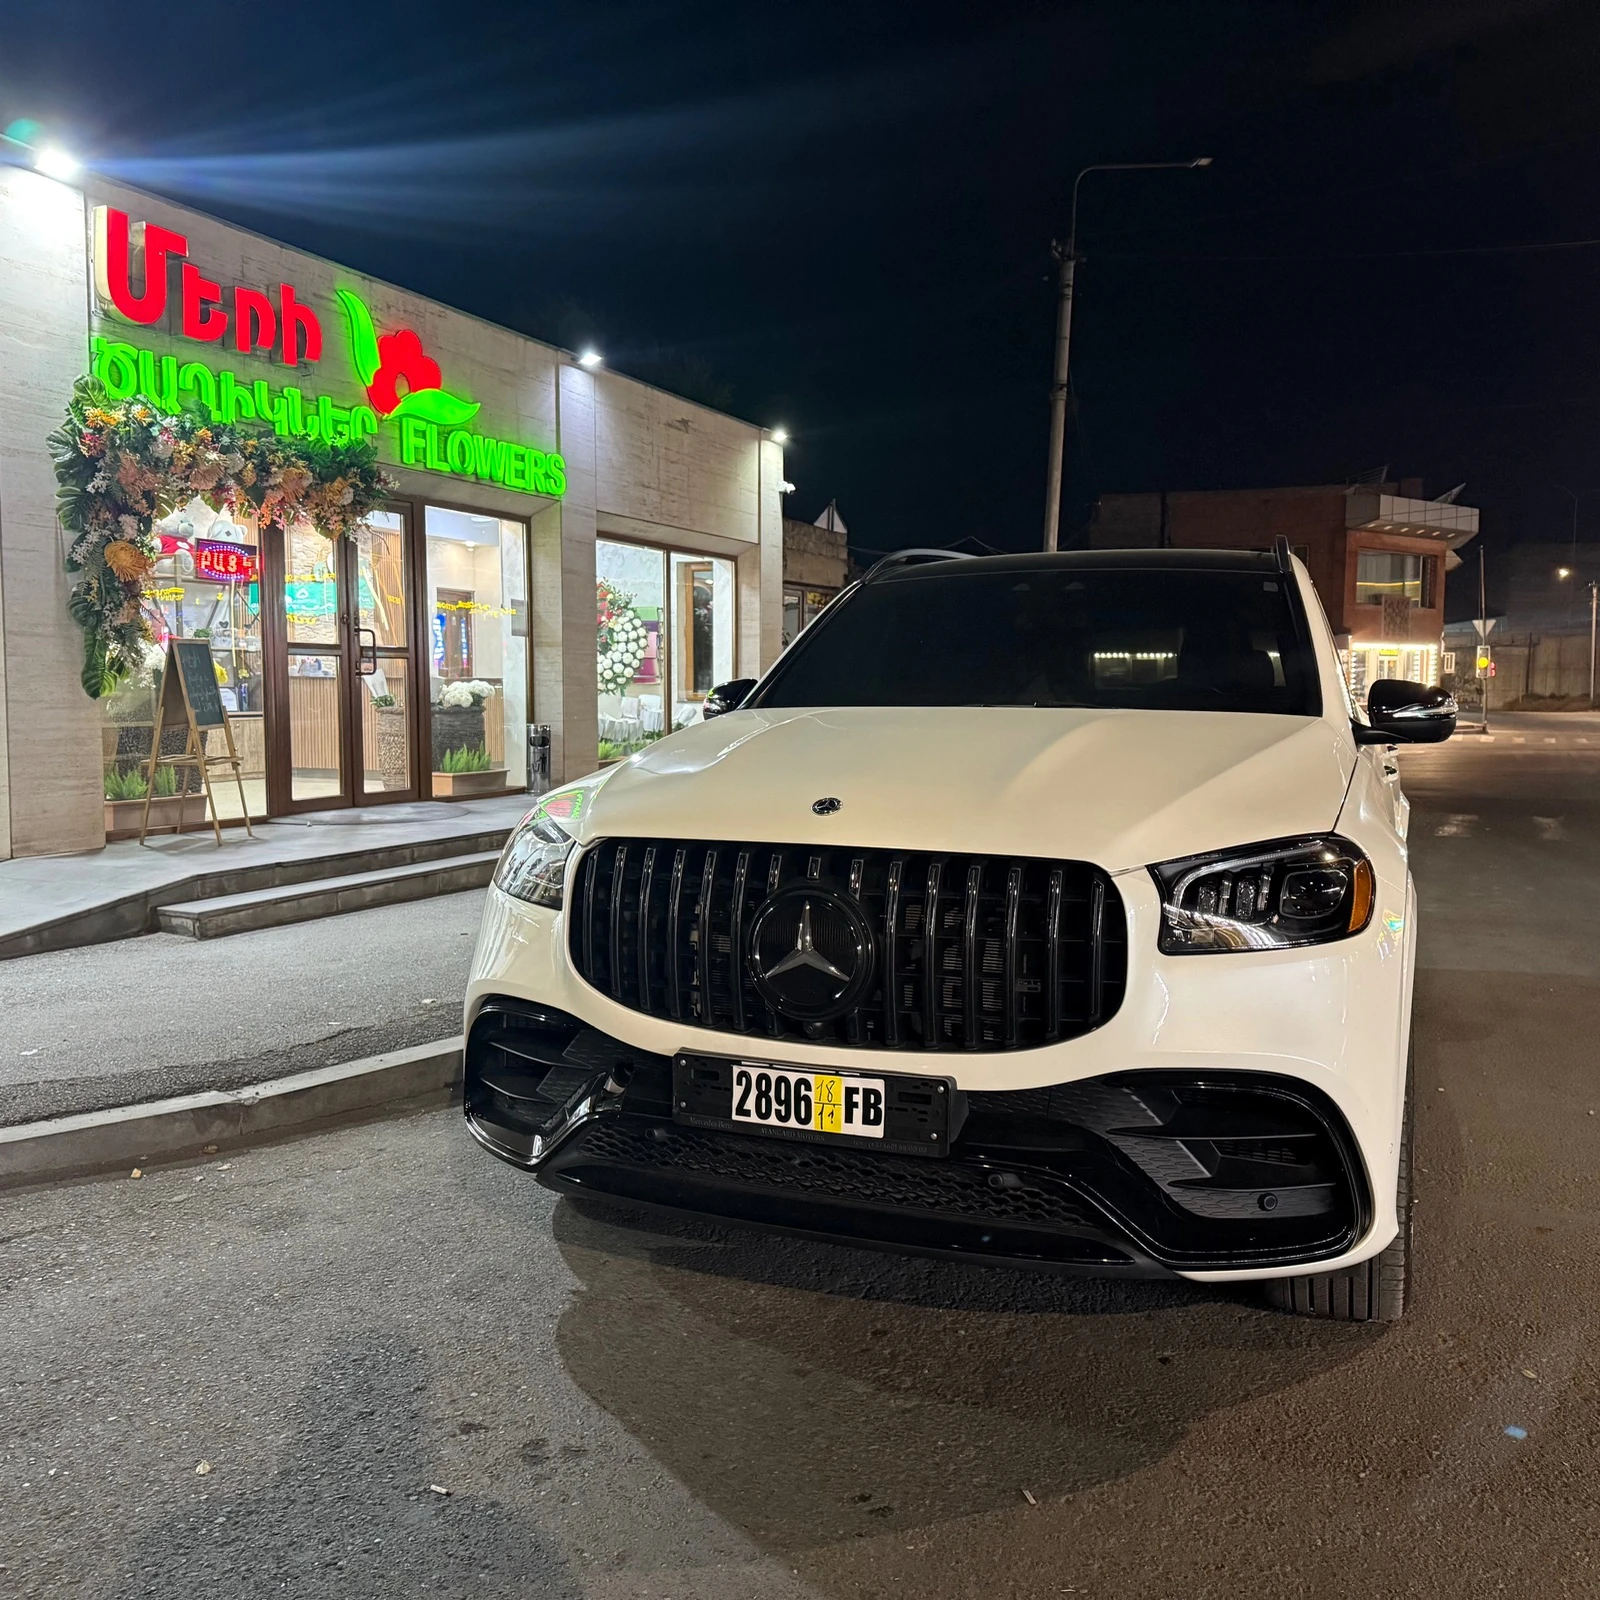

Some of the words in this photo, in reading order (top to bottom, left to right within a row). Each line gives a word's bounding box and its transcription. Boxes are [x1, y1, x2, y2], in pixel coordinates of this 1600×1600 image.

[402, 417, 567, 495] FLOWERS
[735, 1070, 812, 1126] 2896
[844, 1086, 882, 1126] FB
[816, 1079, 835, 1102] 18
